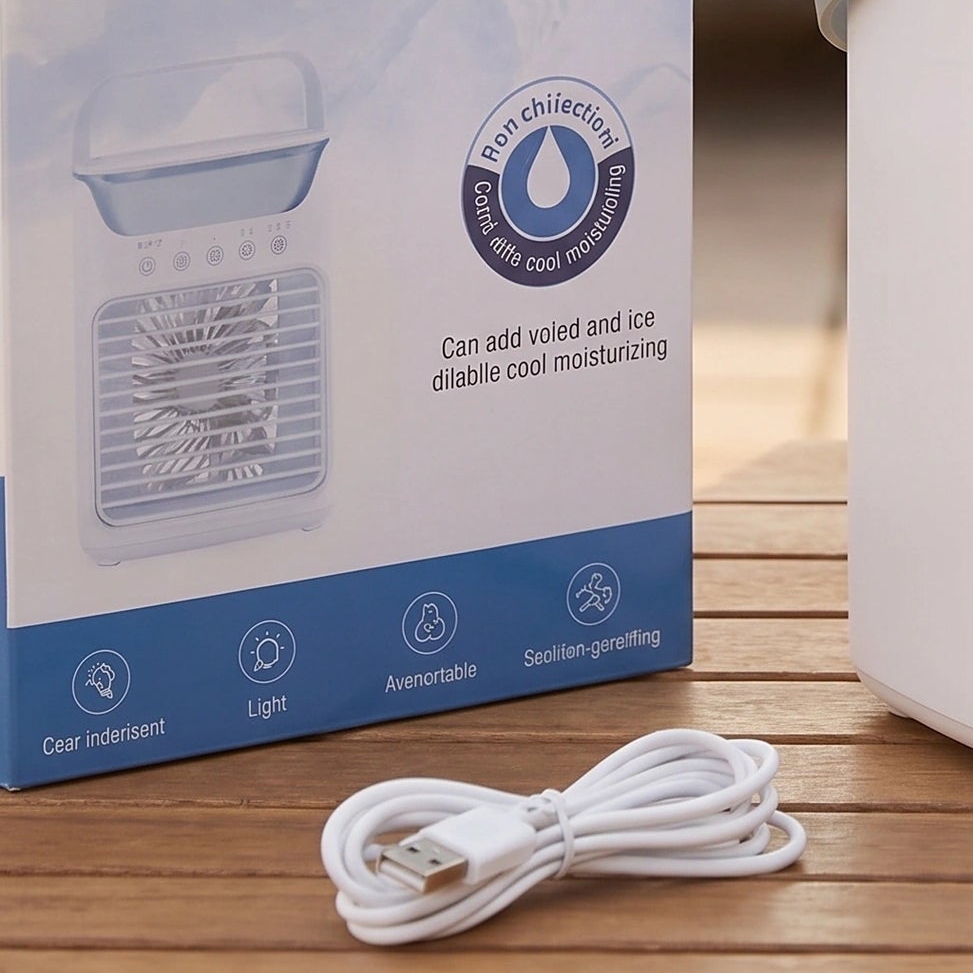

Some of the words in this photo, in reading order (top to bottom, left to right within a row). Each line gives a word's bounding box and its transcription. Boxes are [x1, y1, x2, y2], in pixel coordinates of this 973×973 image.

[525, 251, 561, 273] cool
[442, 337, 479, 359] Can
[486, 326, 522, 353] add
[586, 311, 621, 337] and
[628, 309, 655, 330] ice
[506, 353, 547, 380] cool
[554, 338, 667, 372] moisturizing
[385, 662, 477, 693] Avenortable
[248, 695, 287, 719] Light
[43, 735, 81, 756] Cear
[86, 718, 166, 748] inderisent
